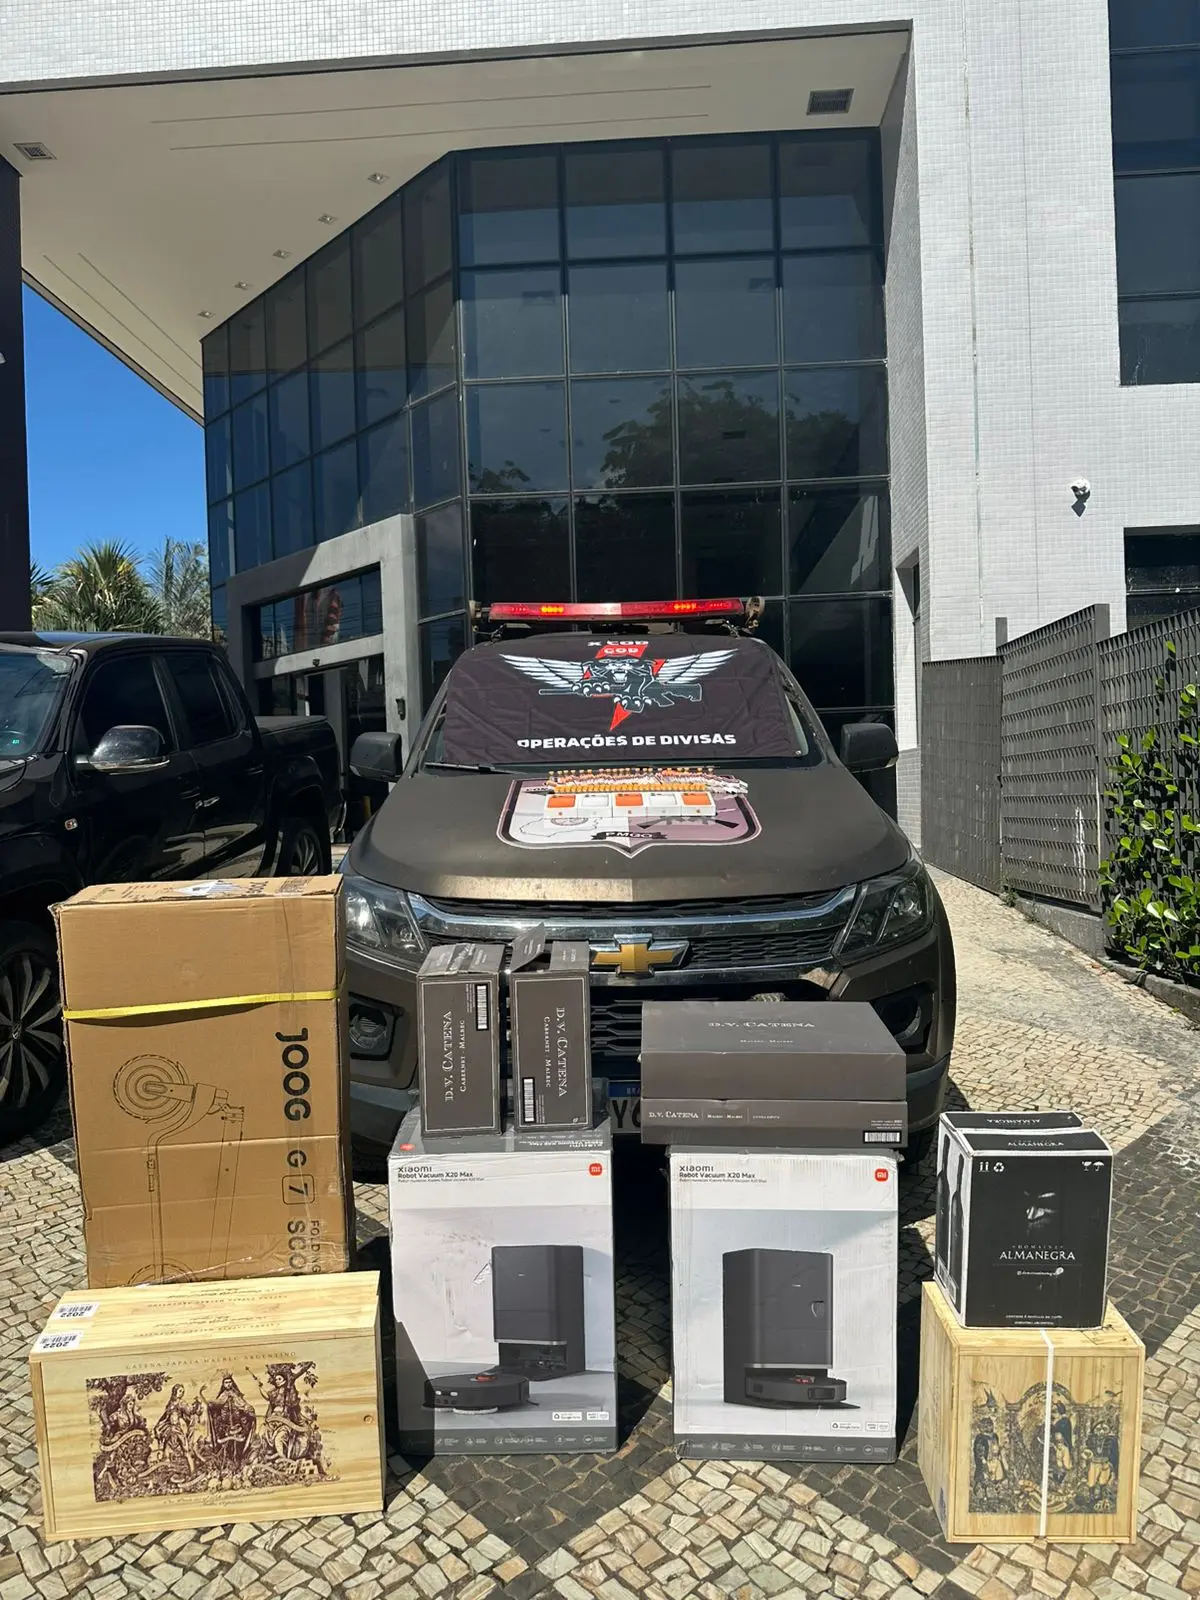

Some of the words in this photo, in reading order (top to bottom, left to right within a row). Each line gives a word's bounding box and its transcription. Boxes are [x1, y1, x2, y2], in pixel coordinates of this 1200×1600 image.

[517, 734, 627, 749] OPERAÇÕES
[632, 736, 656, 746] DE
[660, 733, 736, 746] DIVISAS
[442, 1011, 454, 1072] CATENA
[557, 1037, 568, 1097] CATENA
[275, 1027, 311, 1121] JOOG
[665, 1110, 699, 1119] CATENA
[287, 1220, 307, 1275] SCO
[999, 1250, 1076, 1260] ALMANEGRA
